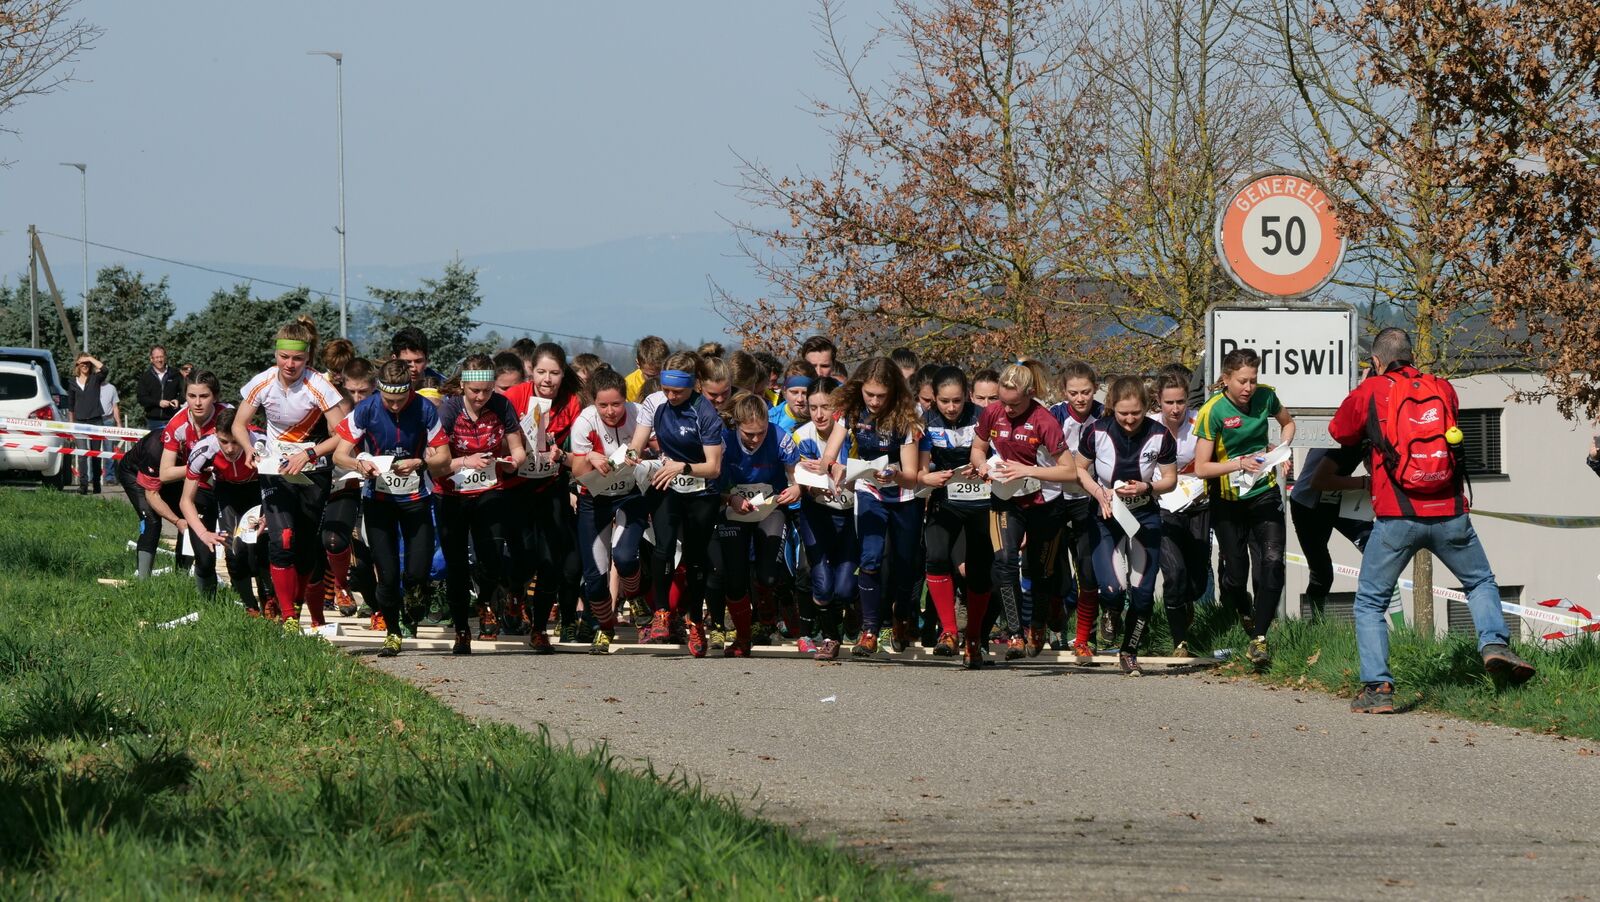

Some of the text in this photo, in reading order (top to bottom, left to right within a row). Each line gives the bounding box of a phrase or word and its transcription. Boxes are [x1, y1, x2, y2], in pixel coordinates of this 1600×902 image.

[1235, 178, 1327, 213] GENERELL
[1261, 215, 1306, 256] 50
[1219, 338, 1344, 375] riswil
[385, 475, 410, 488] 307
[464, 471, 487, 484] 306
[672, 476, 694, 487] 302
[605, 481, 626, 491] 03
[956, 483, 981, 494] 298
